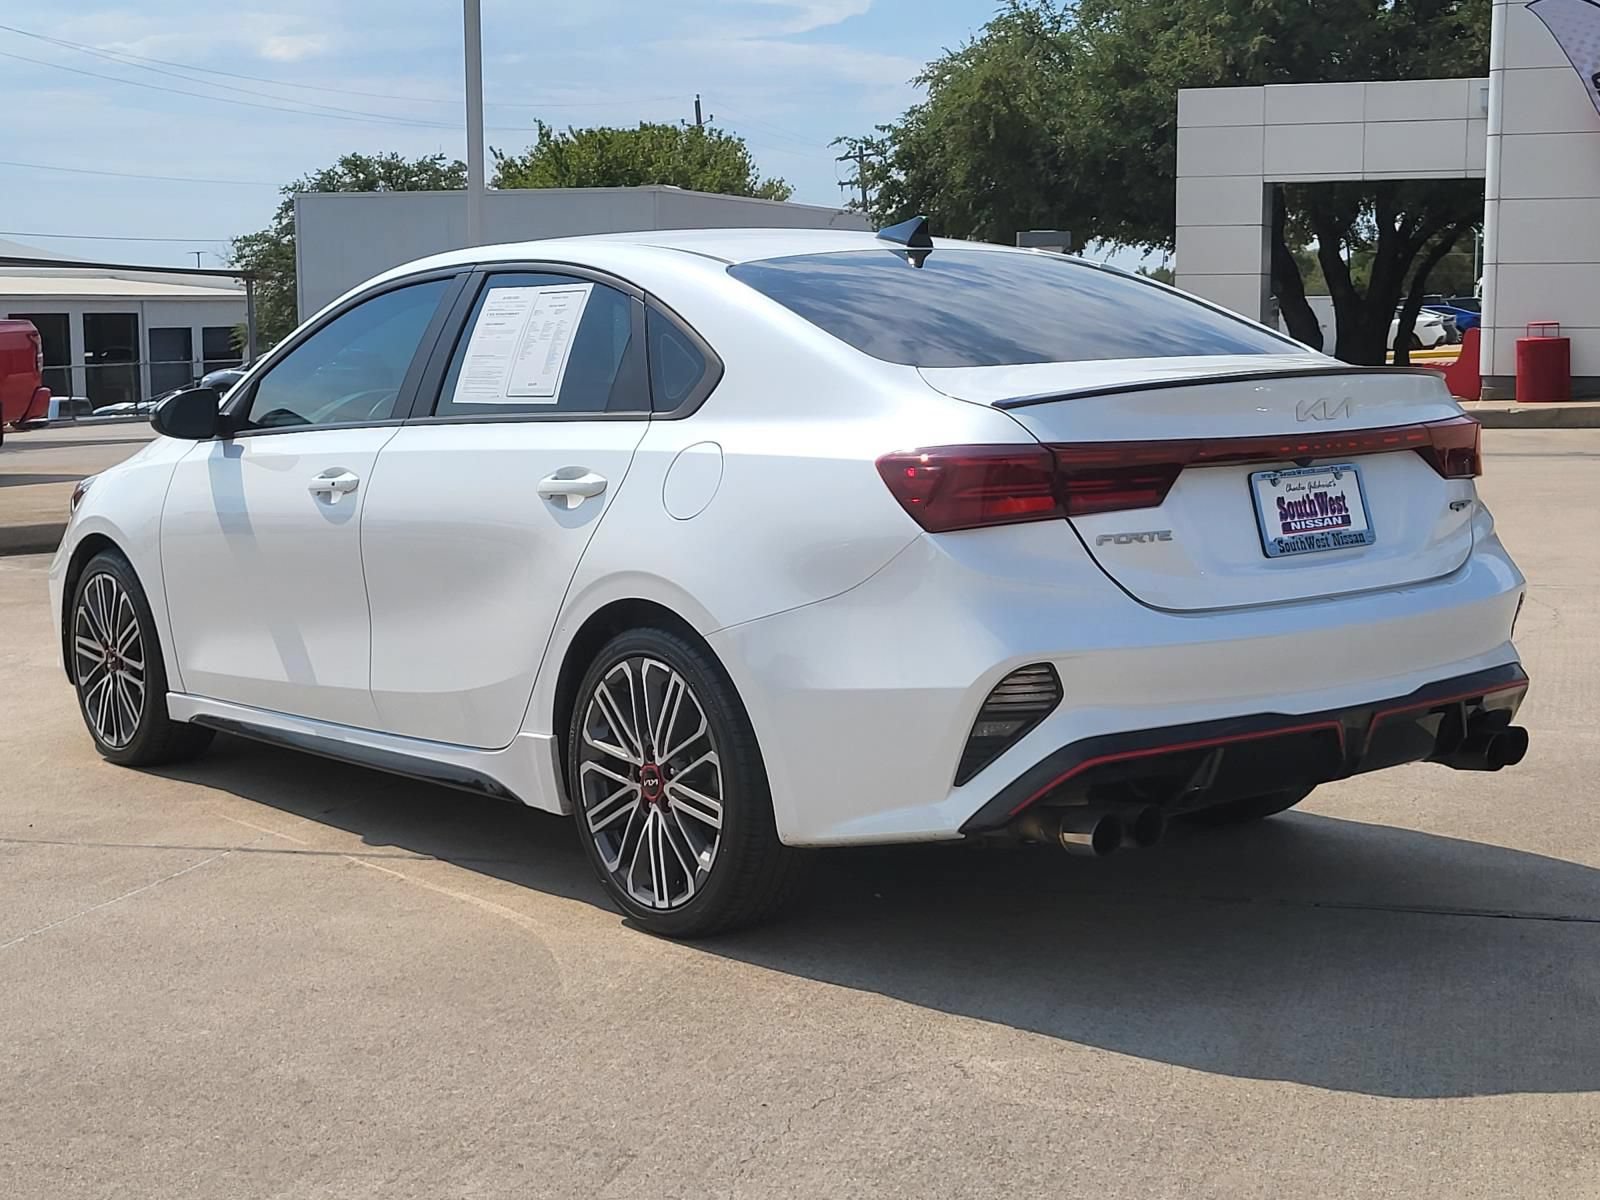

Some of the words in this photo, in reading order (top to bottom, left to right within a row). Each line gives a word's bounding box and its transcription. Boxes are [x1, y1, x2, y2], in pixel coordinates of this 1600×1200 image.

[1295, 397, 1352, 421] KIA
[1276, 490, 1349, 521] SouthWest
[1291, 516, 1342, 530] NISSAN
[1096, 530, 1173, 546] FORTE
[1278, 534, 1331, 553] SouthWest
[1332, 531, 1366, 546] Nissan
